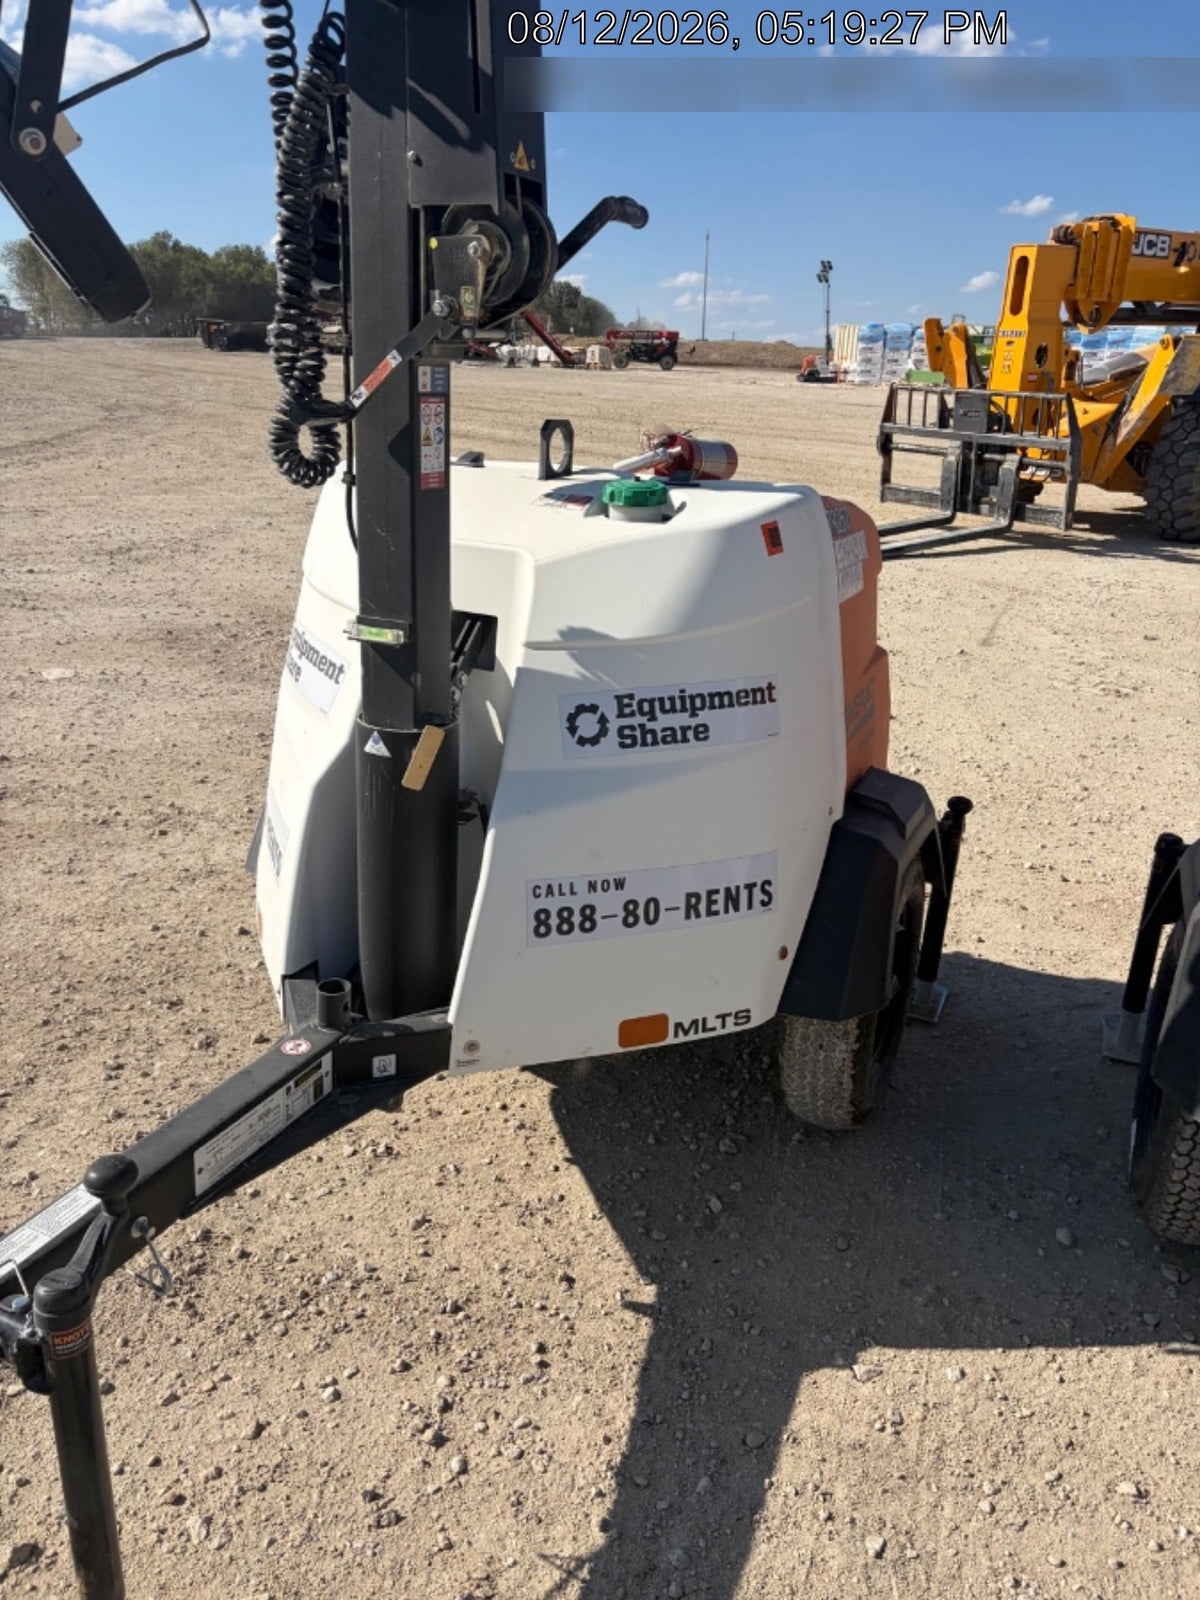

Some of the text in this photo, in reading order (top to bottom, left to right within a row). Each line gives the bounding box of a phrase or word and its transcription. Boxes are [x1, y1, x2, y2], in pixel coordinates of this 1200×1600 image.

[1131, 232, 1171, 257] JCB
[614, 682, 776, 722] Equipment
[617, 723, 710, 749] Share
[532, 877, 627, 899] CALL NOW
[533, 880, 773, 939] 888-80-RENTS
[673, 1008, 752, 1038] MLTS
